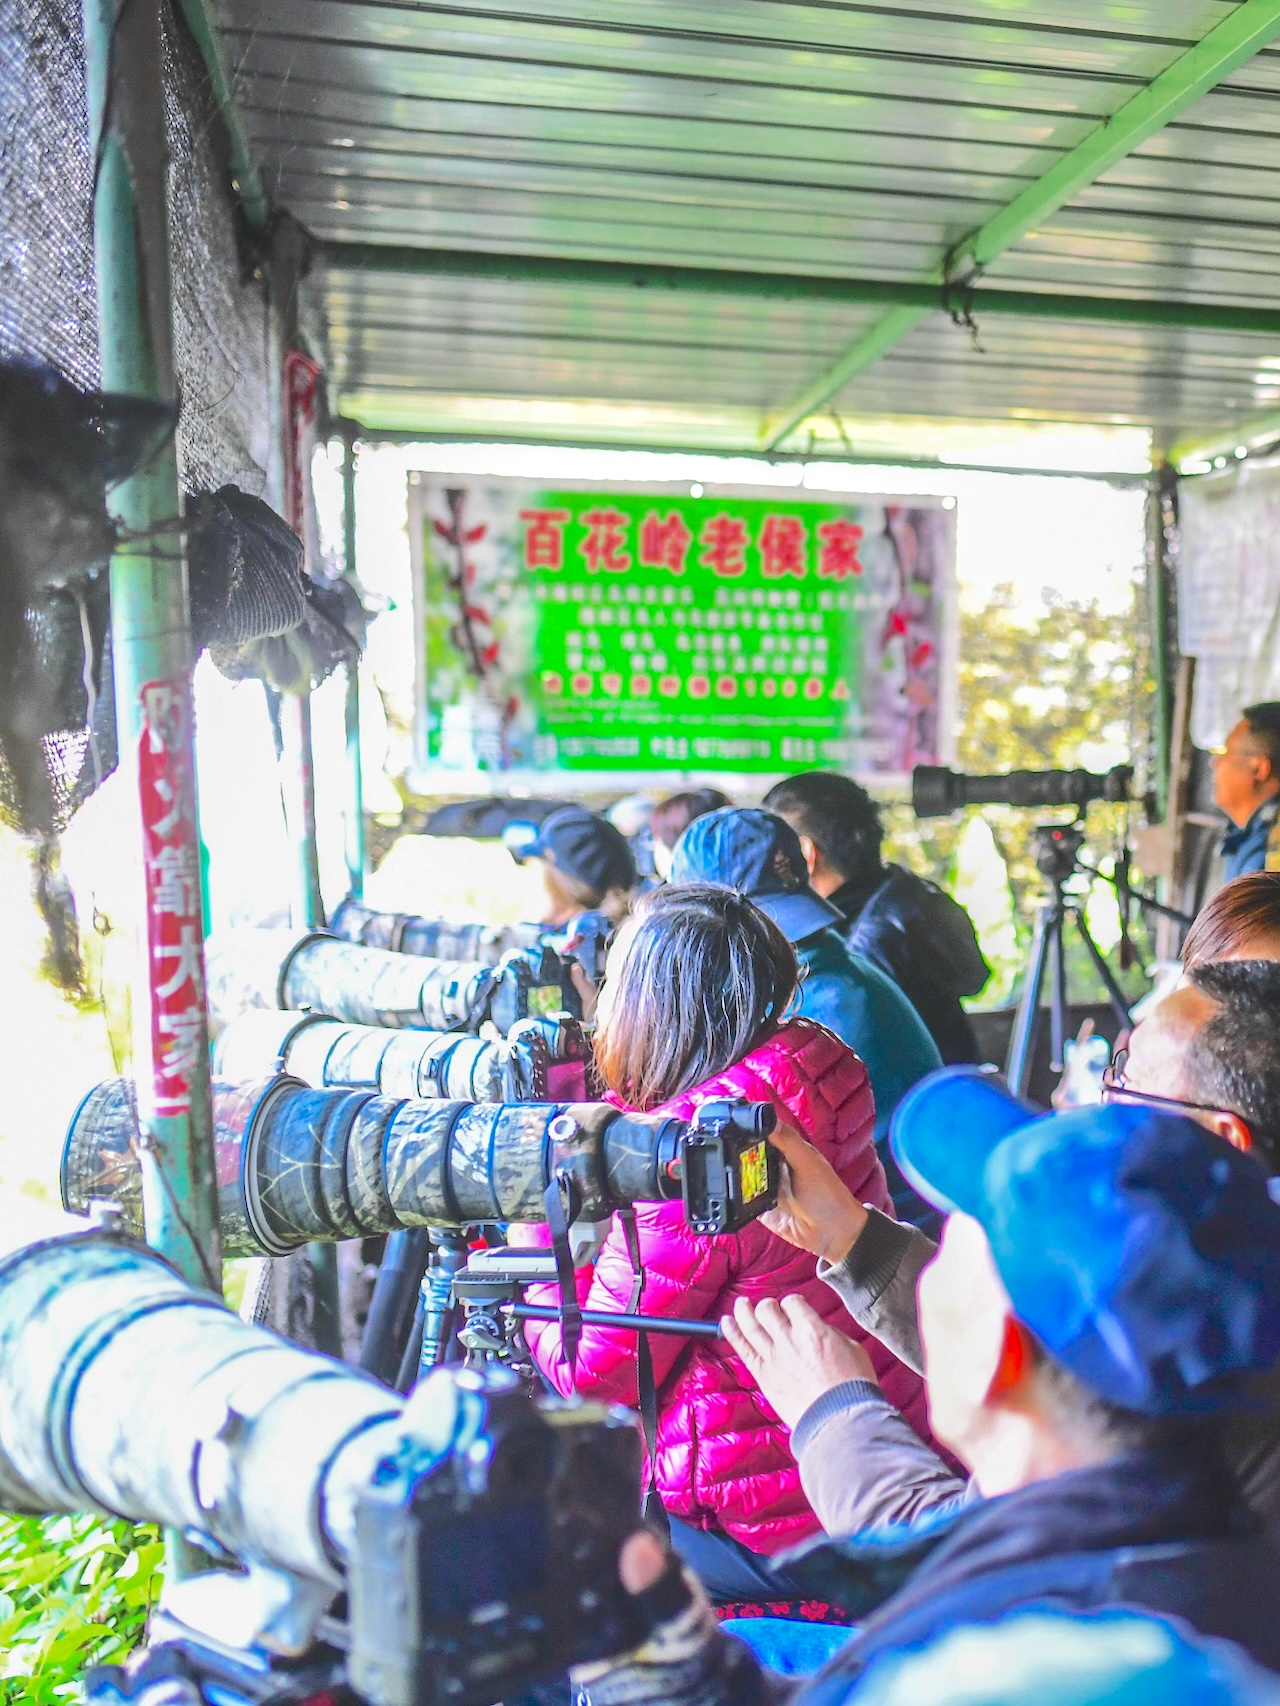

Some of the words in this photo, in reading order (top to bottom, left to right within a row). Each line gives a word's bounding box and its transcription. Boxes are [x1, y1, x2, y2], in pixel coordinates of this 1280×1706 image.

[519, 509, 864, 577] 百花岭老侯家
[147, 686, 200, 1108] 防火靠大家
